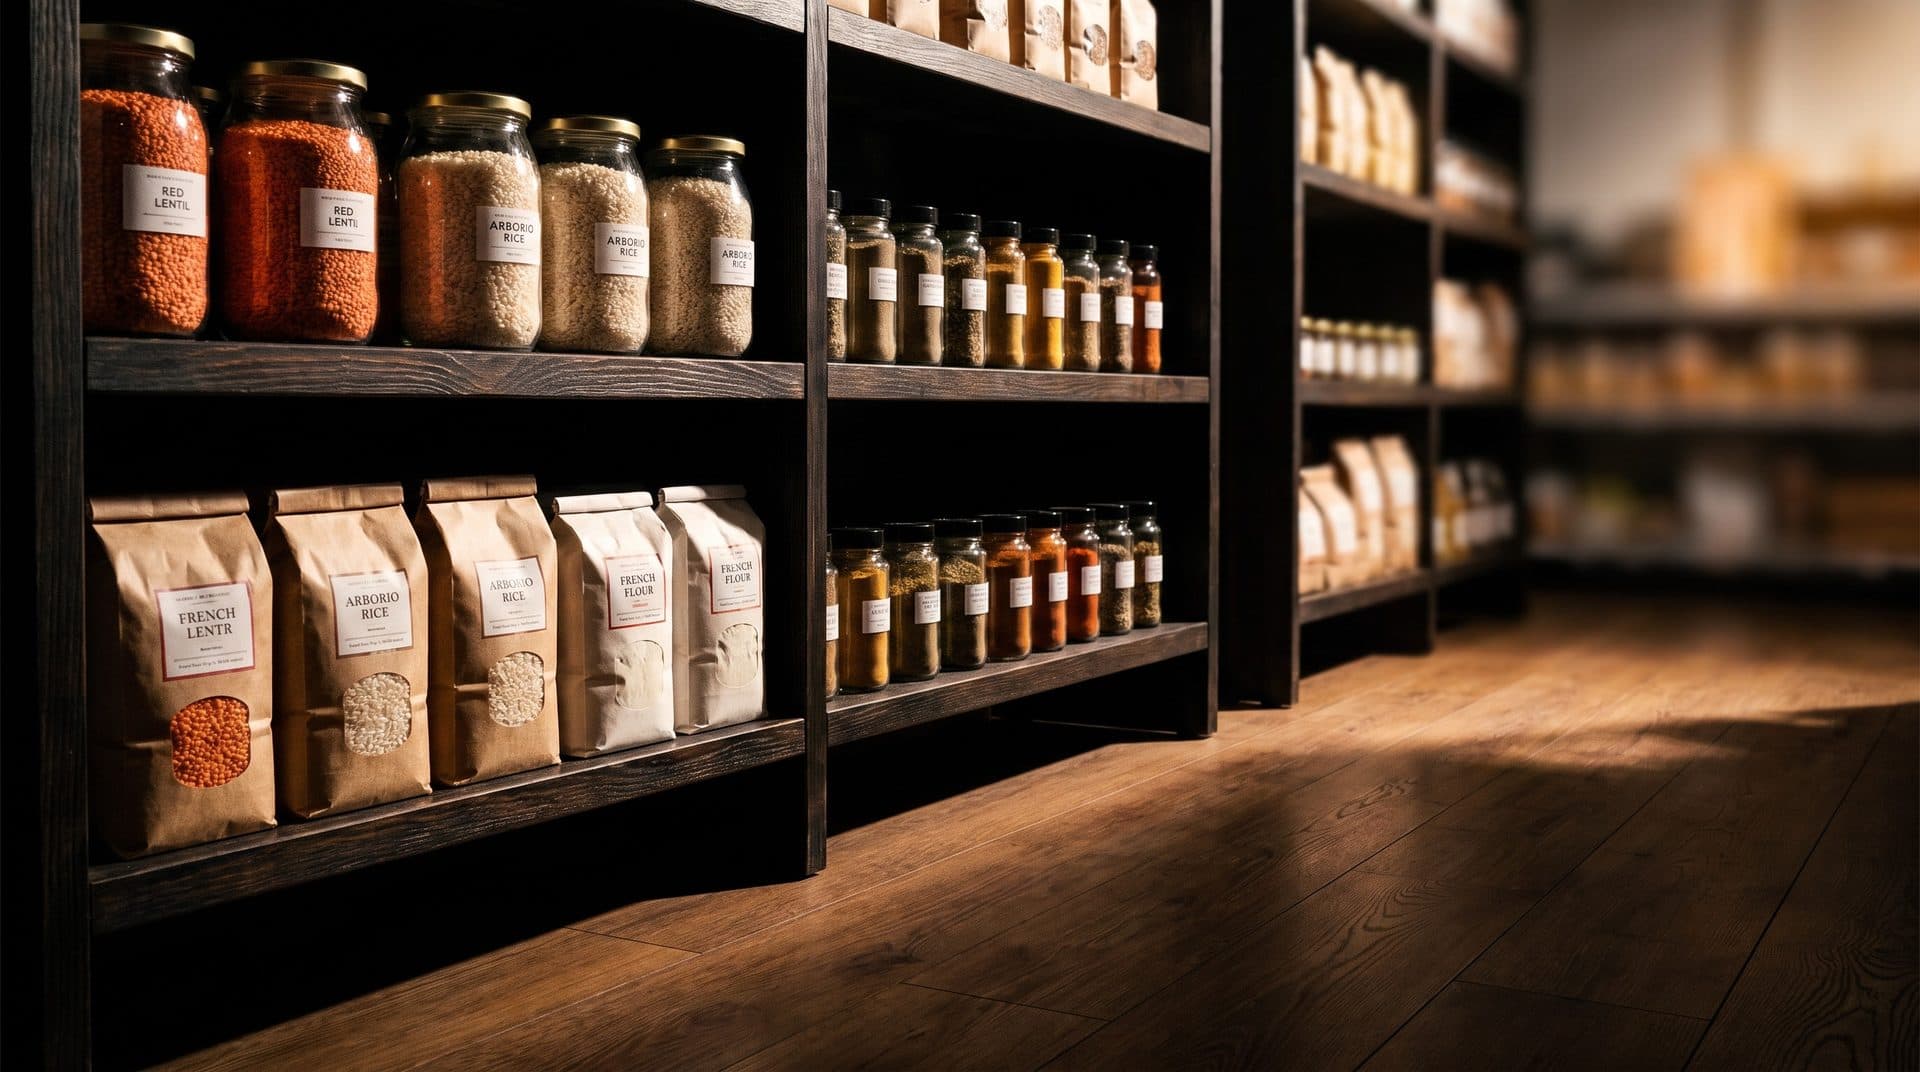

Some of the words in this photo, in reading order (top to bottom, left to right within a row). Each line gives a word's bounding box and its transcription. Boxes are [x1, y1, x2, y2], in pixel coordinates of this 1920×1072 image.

[162, 186, 184, 198] RED
[154, 197, 191, 211] LENTIL
[334, 205, 354, 216] RED
[489, 220, 534, 234] ARBORIO
[503, 233, 525, 243] RICE
[606, 235, 645, 248] ARBORIO
[620, 247, 638, 257] RICE
[732, 259, 747, 269] RICE
[720, 561, 753, 574] FRENCH
[620, 572, 656, 586] FRENCH
[725, 572, 752, 584] FLOUR
[502, 590, 526, 602] RICE
[624, 585, 654, 597] FLOUR
[345, 591, 400, 607] ARBORIO
[178, 607, 236, 624] FRENCH
[361, 606, 389, 620] RICE
[187, 623, 233, 639] LENTR
